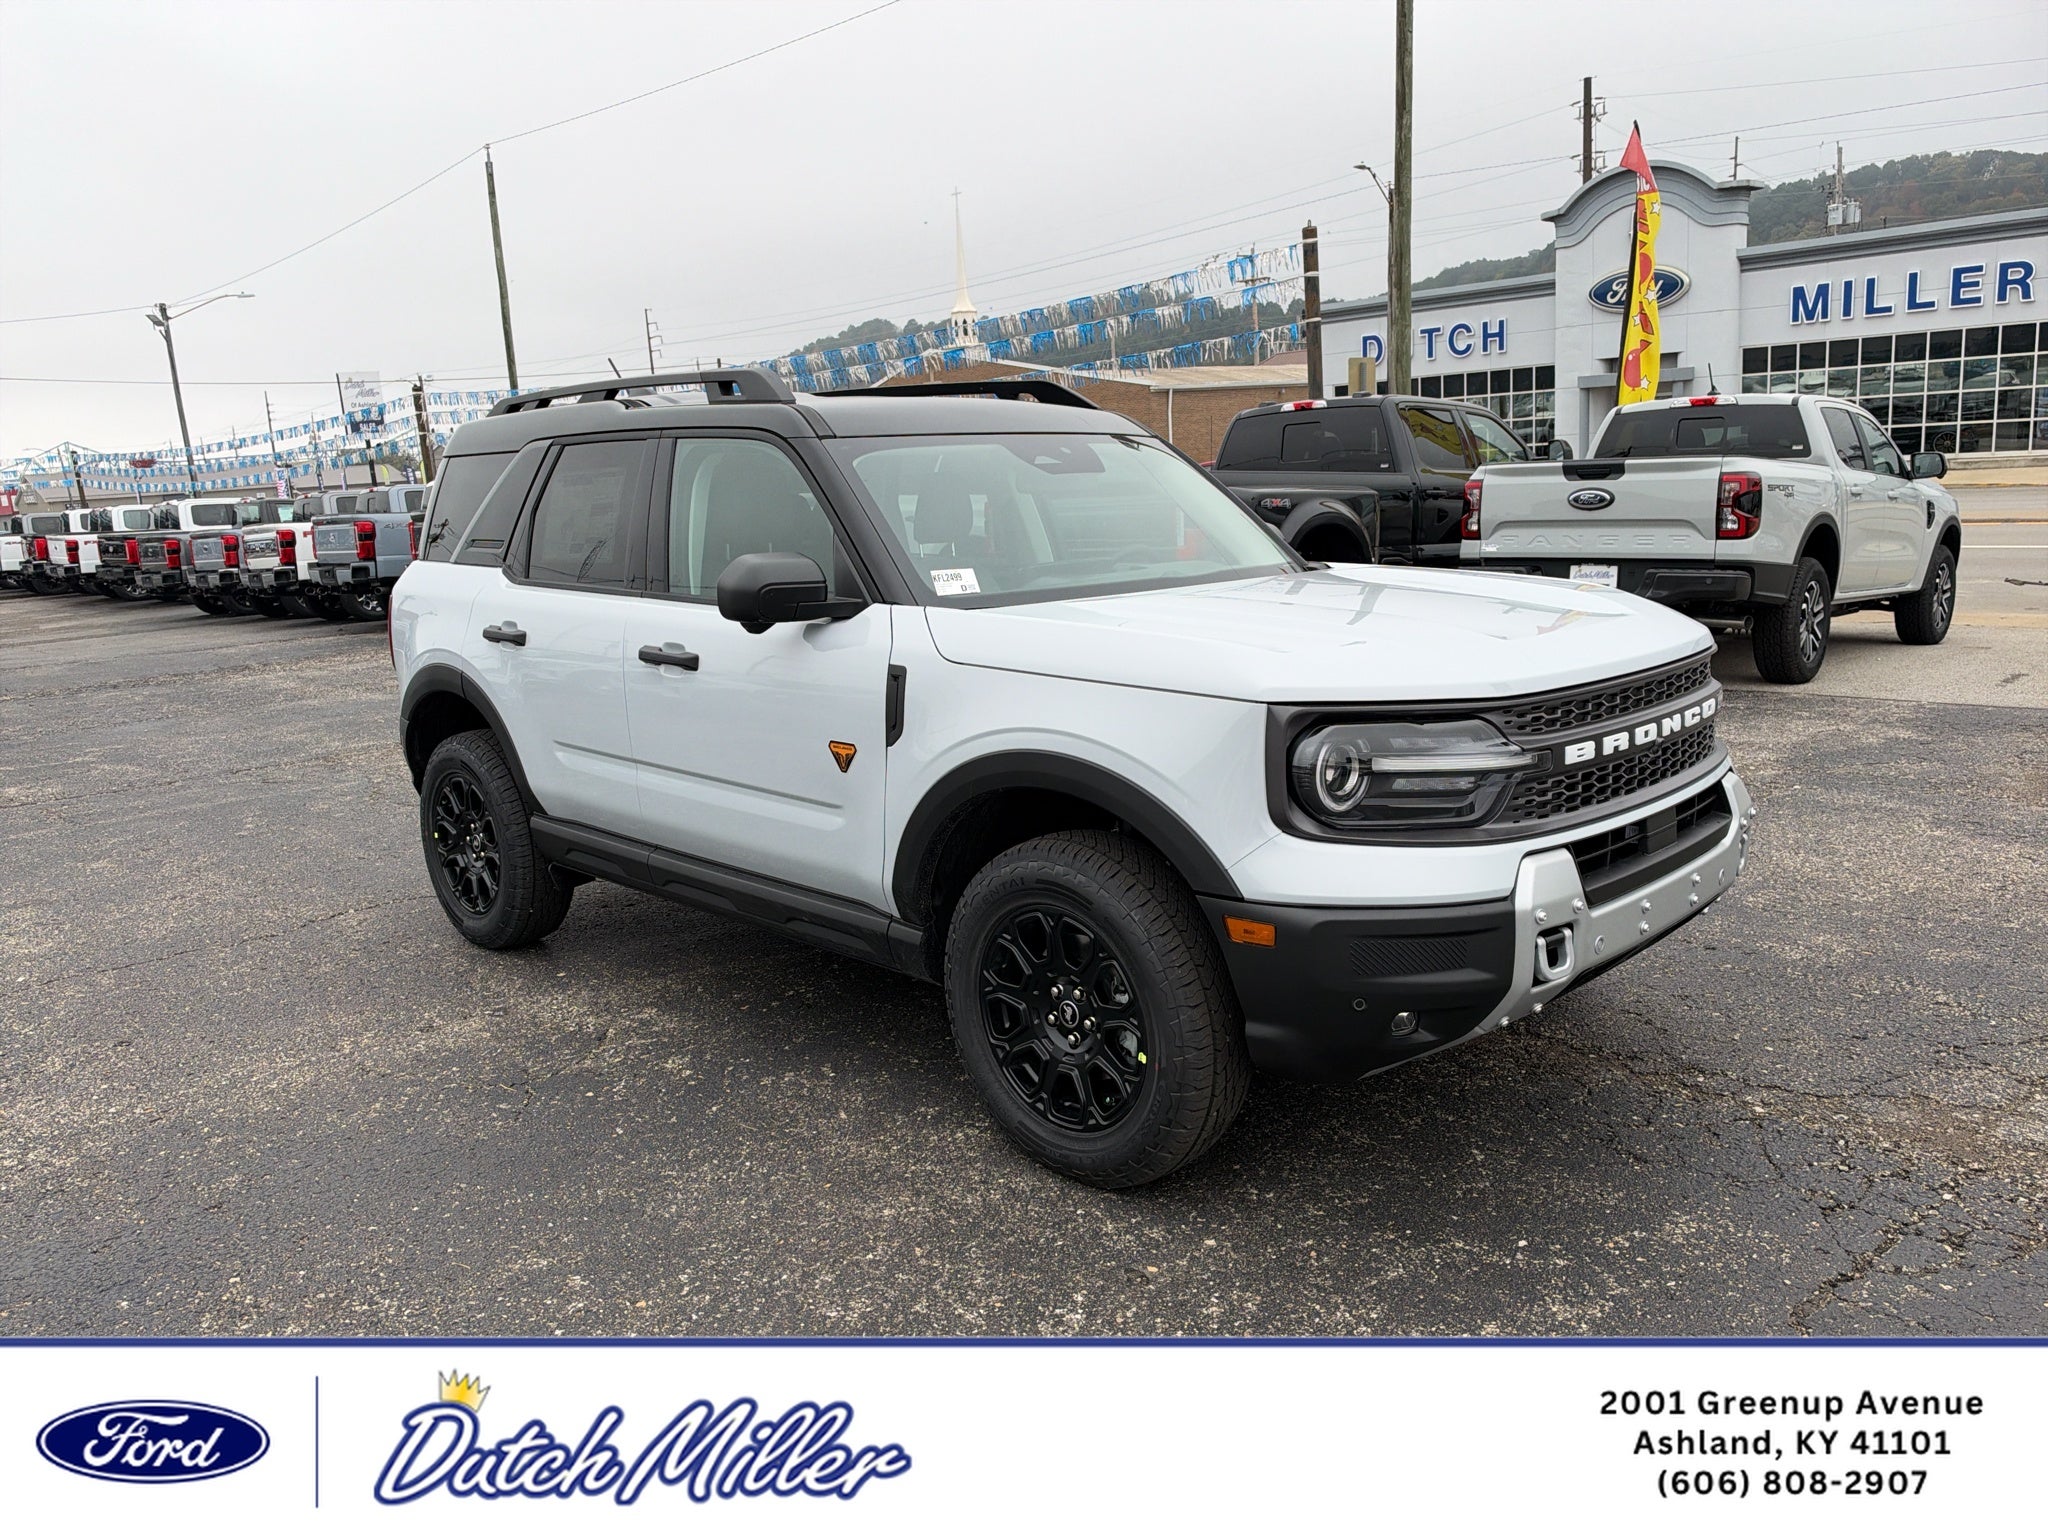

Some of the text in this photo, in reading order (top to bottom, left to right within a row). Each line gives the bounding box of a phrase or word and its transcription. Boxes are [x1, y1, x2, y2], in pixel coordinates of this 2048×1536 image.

[1790, 259, 2036, 325] MILLER
[1360, 317, 1508, 366] DTCH
[1767, 484, 1795, 492] SPORT
[1500, 534, 1691, 548] RANGER
[932, 572, 963, 583] KFL2499
[1564, 697, 1716, 765] BRONCO
